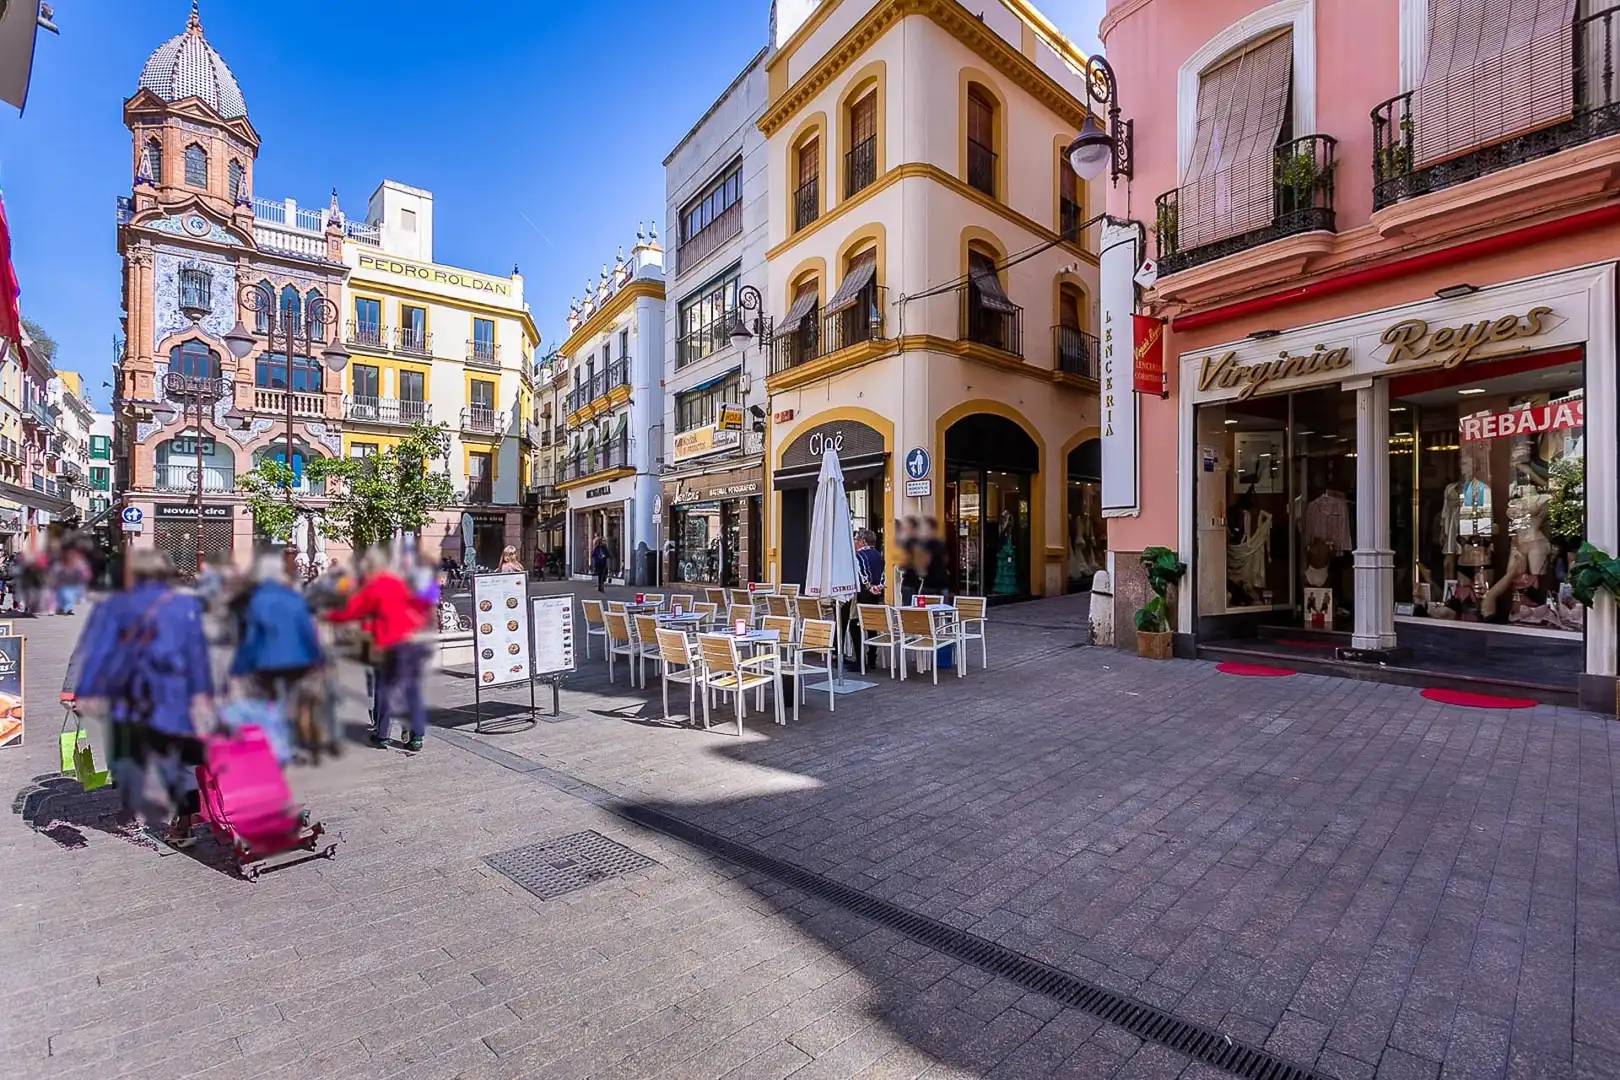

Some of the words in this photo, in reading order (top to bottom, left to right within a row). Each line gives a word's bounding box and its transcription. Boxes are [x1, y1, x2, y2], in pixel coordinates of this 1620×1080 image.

[359, 255, 429, 279] PEDRO
[434, 271, 507, 295] ROLDAN
[1104, 310, 1115, 437] LENCERIA
[1197, 343, 1352, 400] Virginia
[1380, 305, 1554, 369] Reyes
[163, 507, 200, 515] NOVIA
[204, 507, 226, 515] cira
